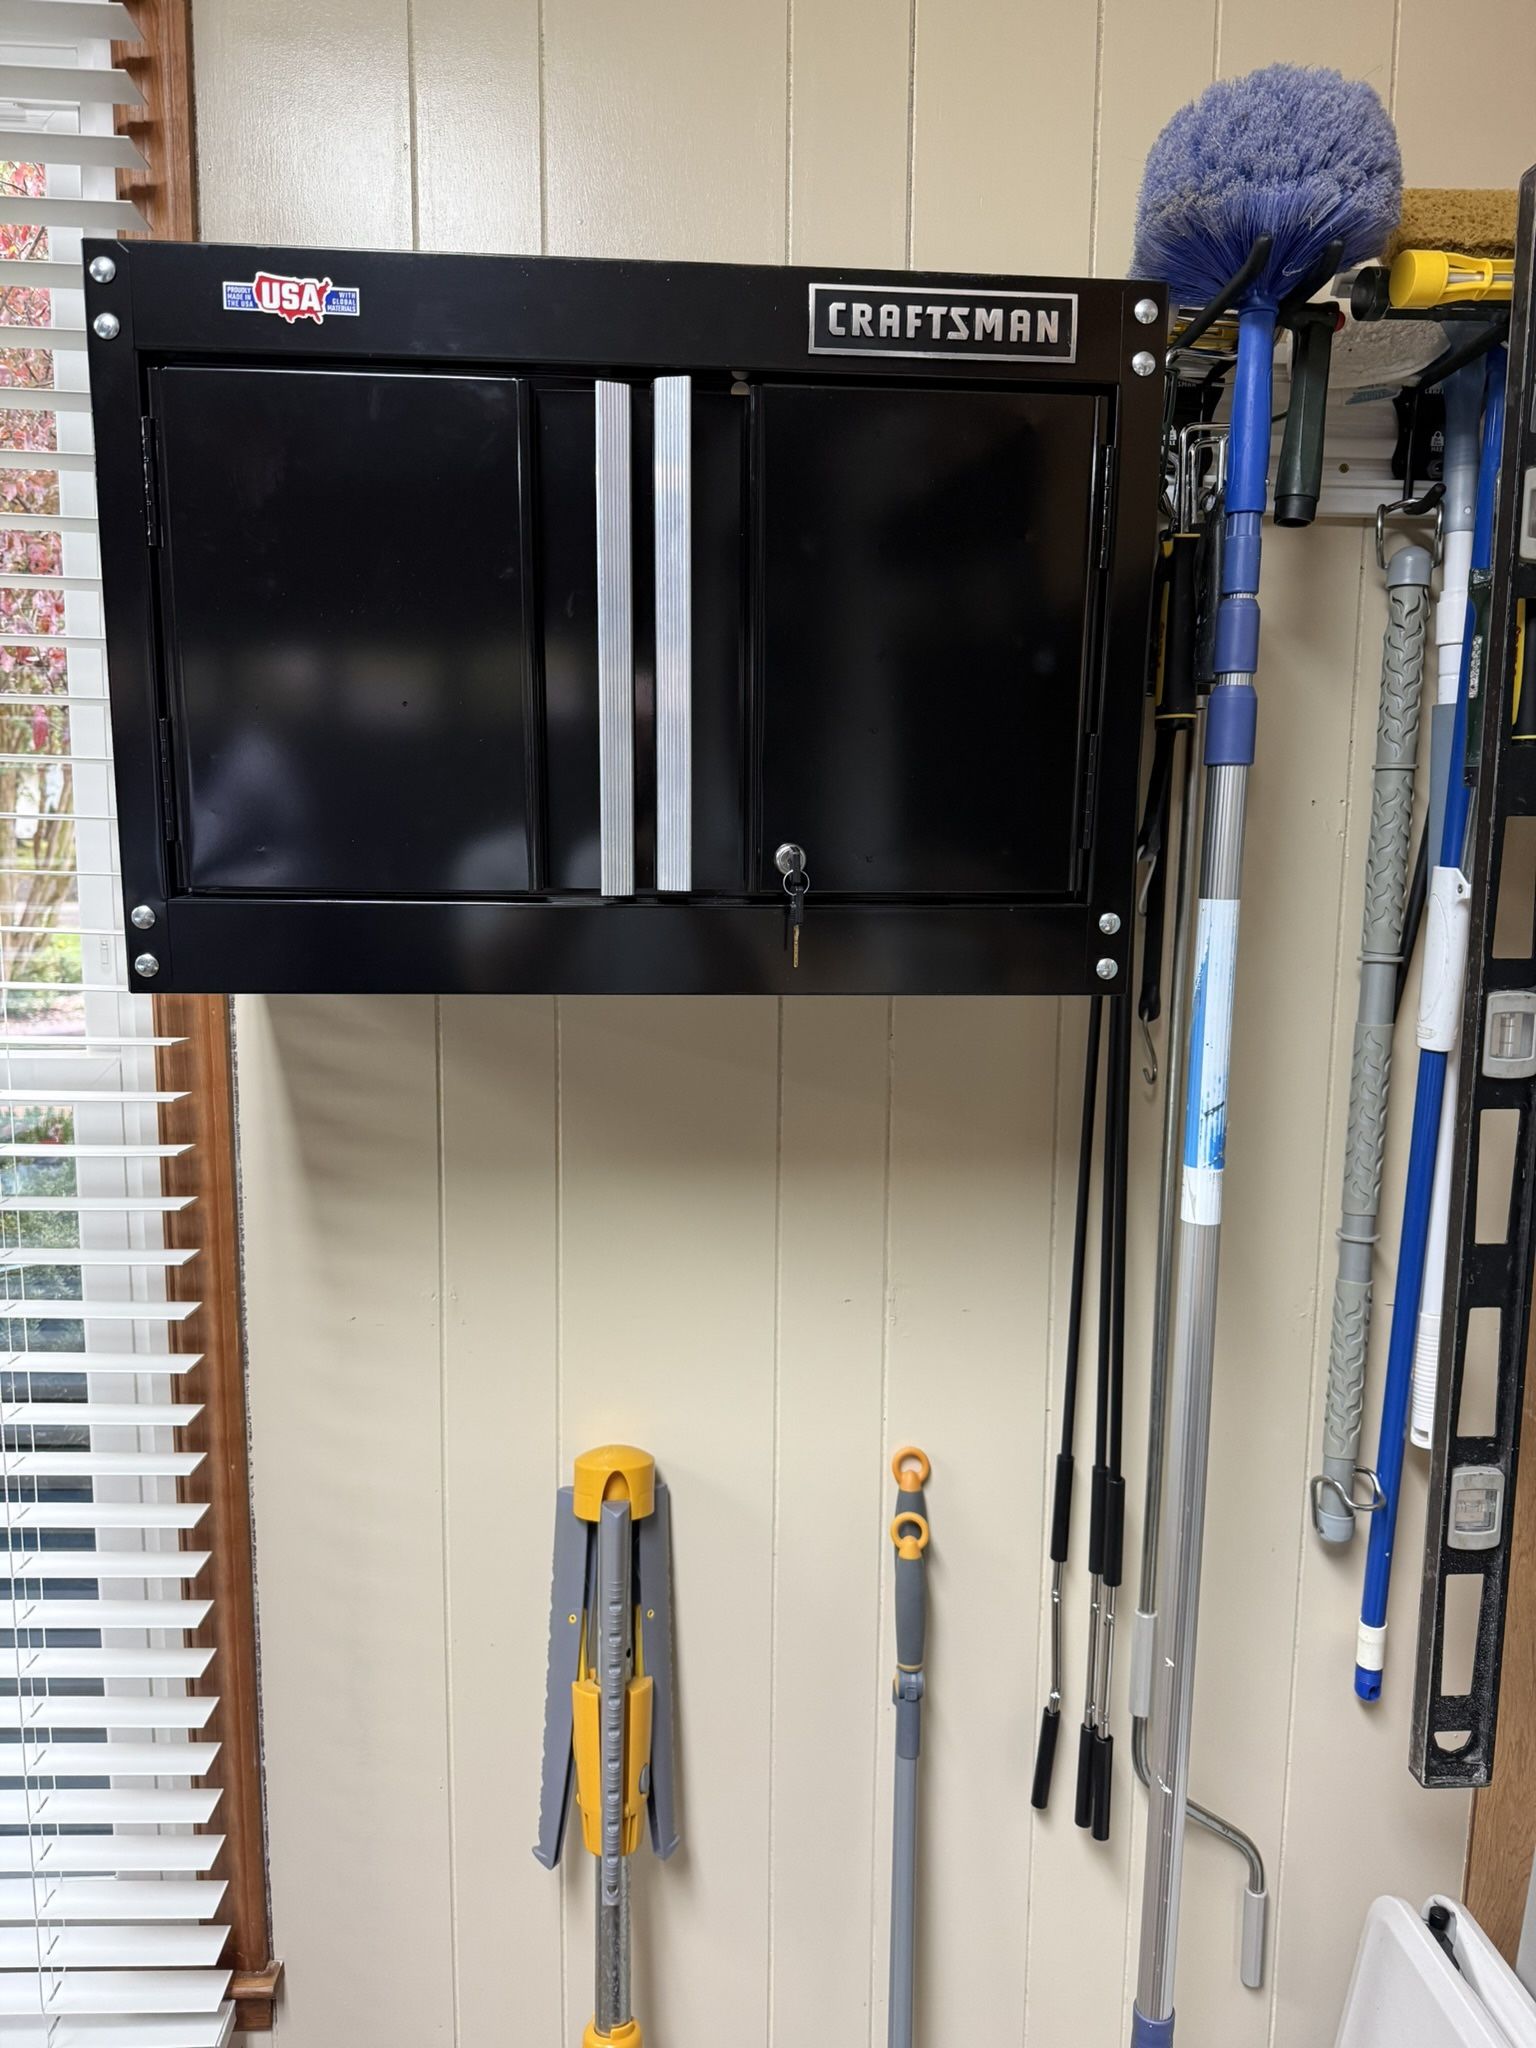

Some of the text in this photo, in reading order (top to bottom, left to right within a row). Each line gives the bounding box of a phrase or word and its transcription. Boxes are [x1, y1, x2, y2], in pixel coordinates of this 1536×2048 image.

[227, 286, 252, 294] PROUDLY
[261, 281, 321, 311] USA
[240, 300, 254, 308] USA
[332, 298, 356, 306] GLOBAL
[327, 304, 356, 312] MATERIALS
[828, 302, 1059, 344] CRAFTSMAN
